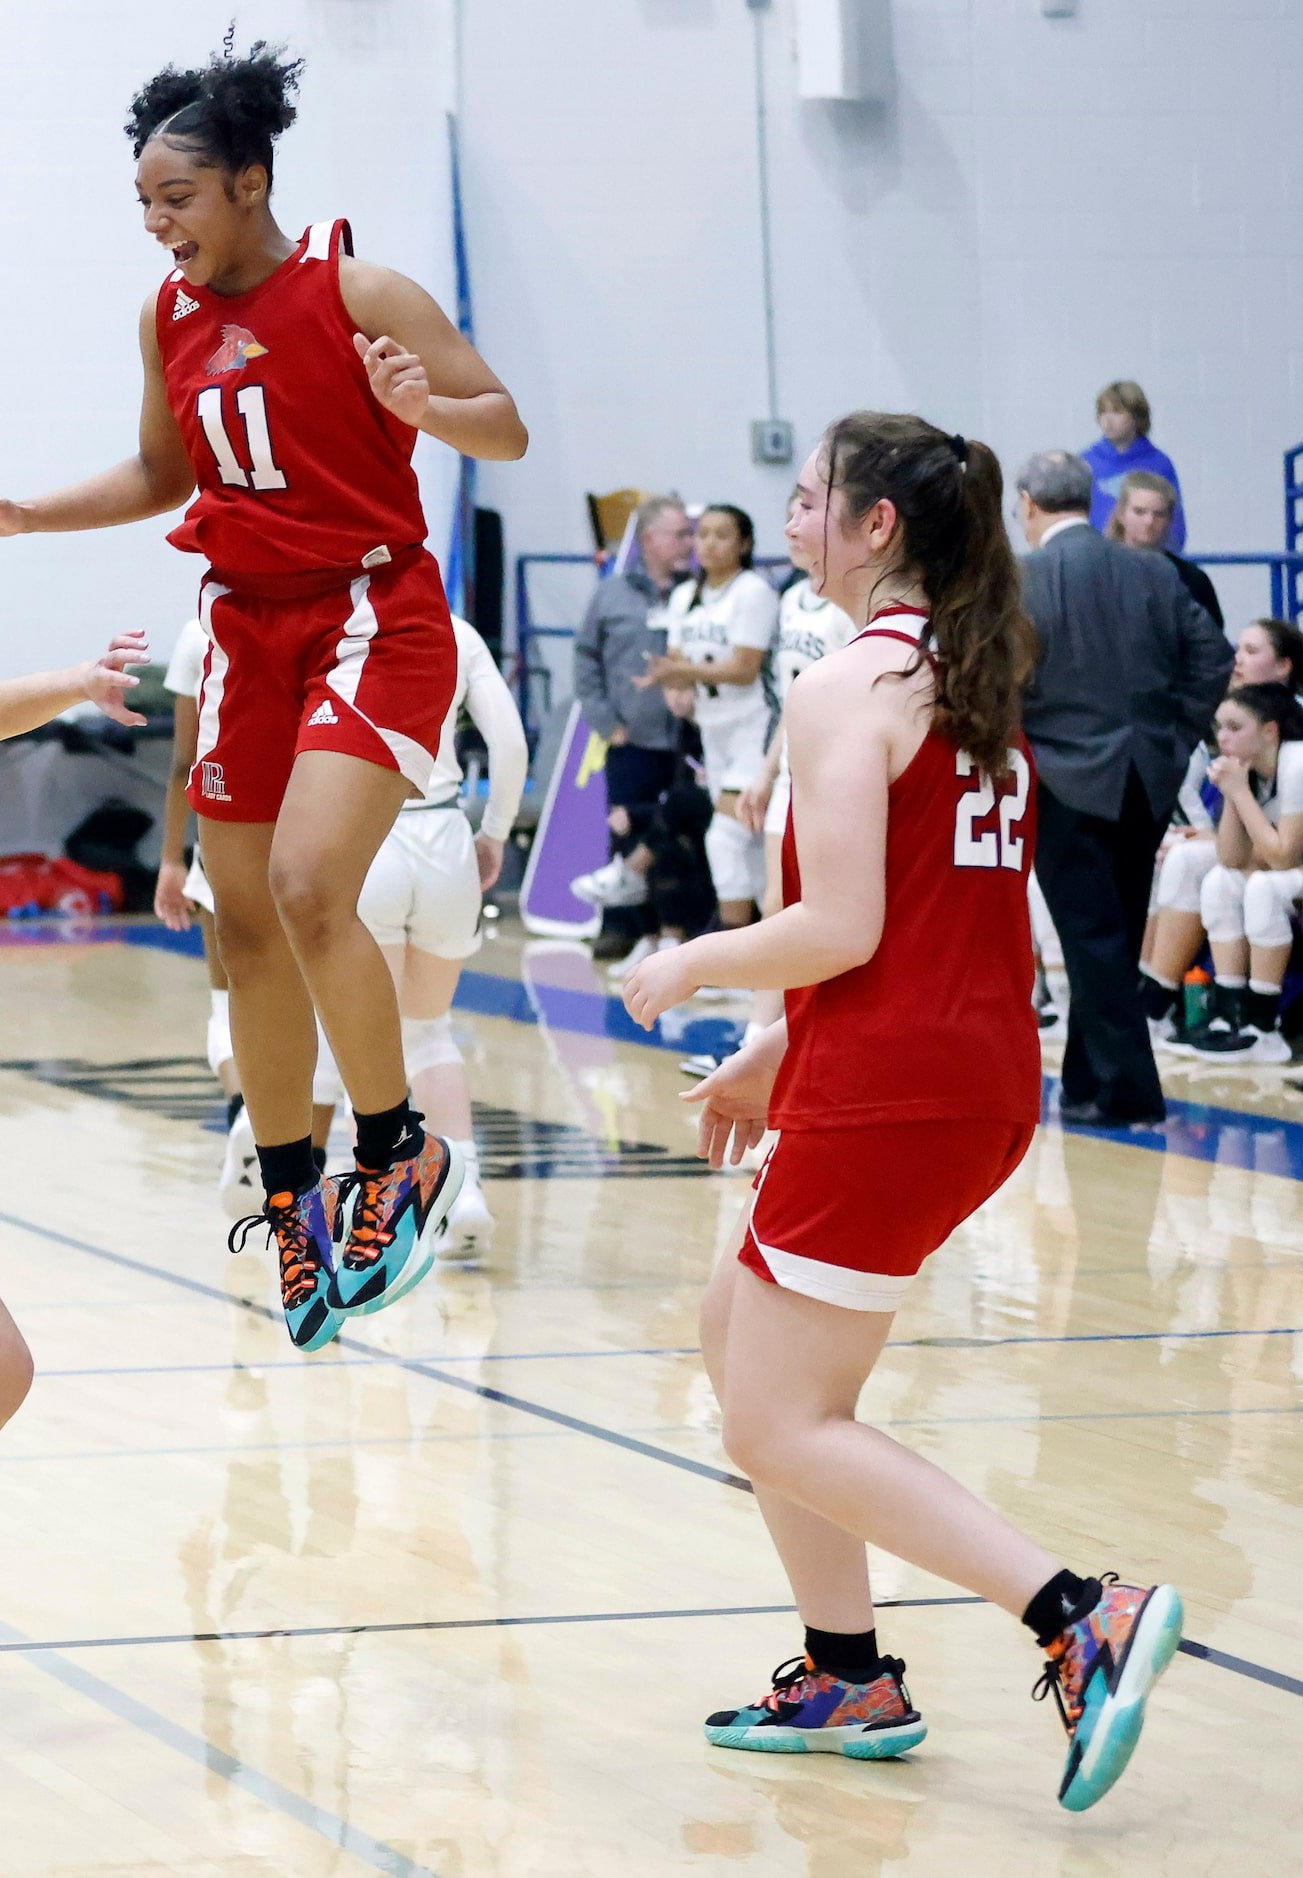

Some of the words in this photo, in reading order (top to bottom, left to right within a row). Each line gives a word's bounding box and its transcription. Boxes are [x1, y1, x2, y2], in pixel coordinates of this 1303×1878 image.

[172, 300, 201, 321] adidas
[197, 385, 288, 492] 11
[953, 747, 1030, 872] 22
